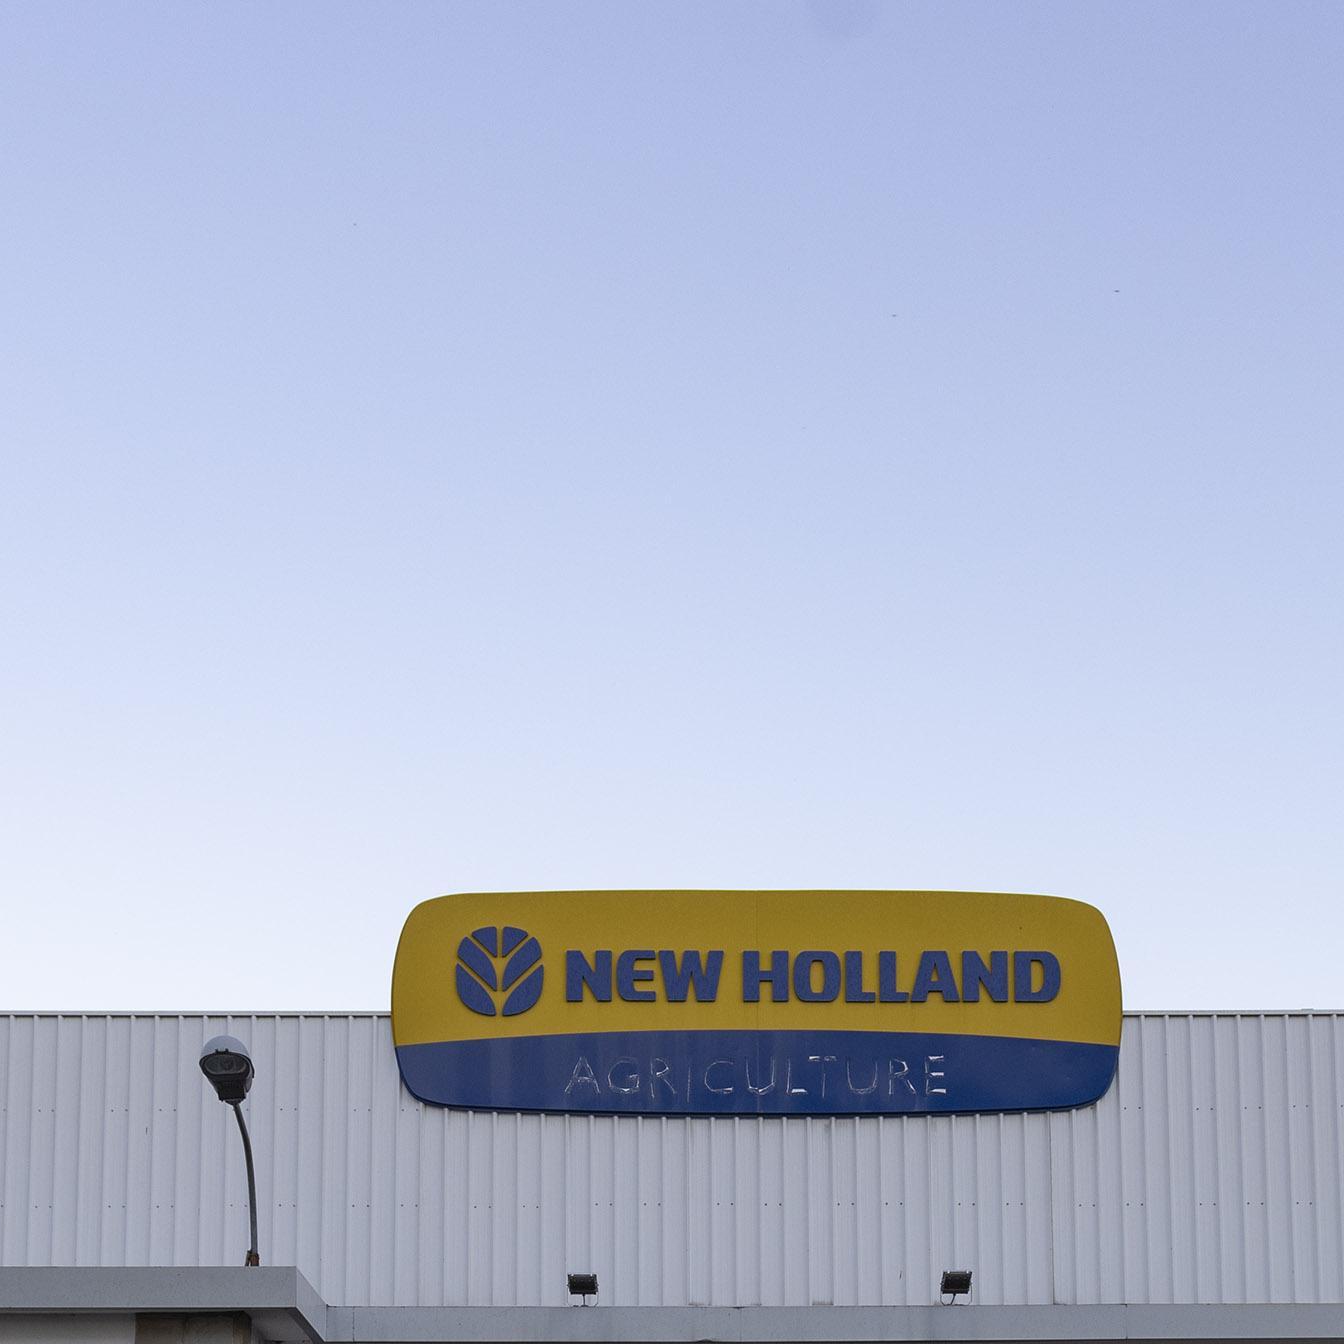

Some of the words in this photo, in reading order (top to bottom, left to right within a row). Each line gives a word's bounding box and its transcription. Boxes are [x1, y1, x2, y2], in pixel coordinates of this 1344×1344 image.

[564, 949, 724, 1003] NEW
[742, 950, 1063, 1004] HOLLAND
[563, 1054, 947, 1099] AGRICULTURE
